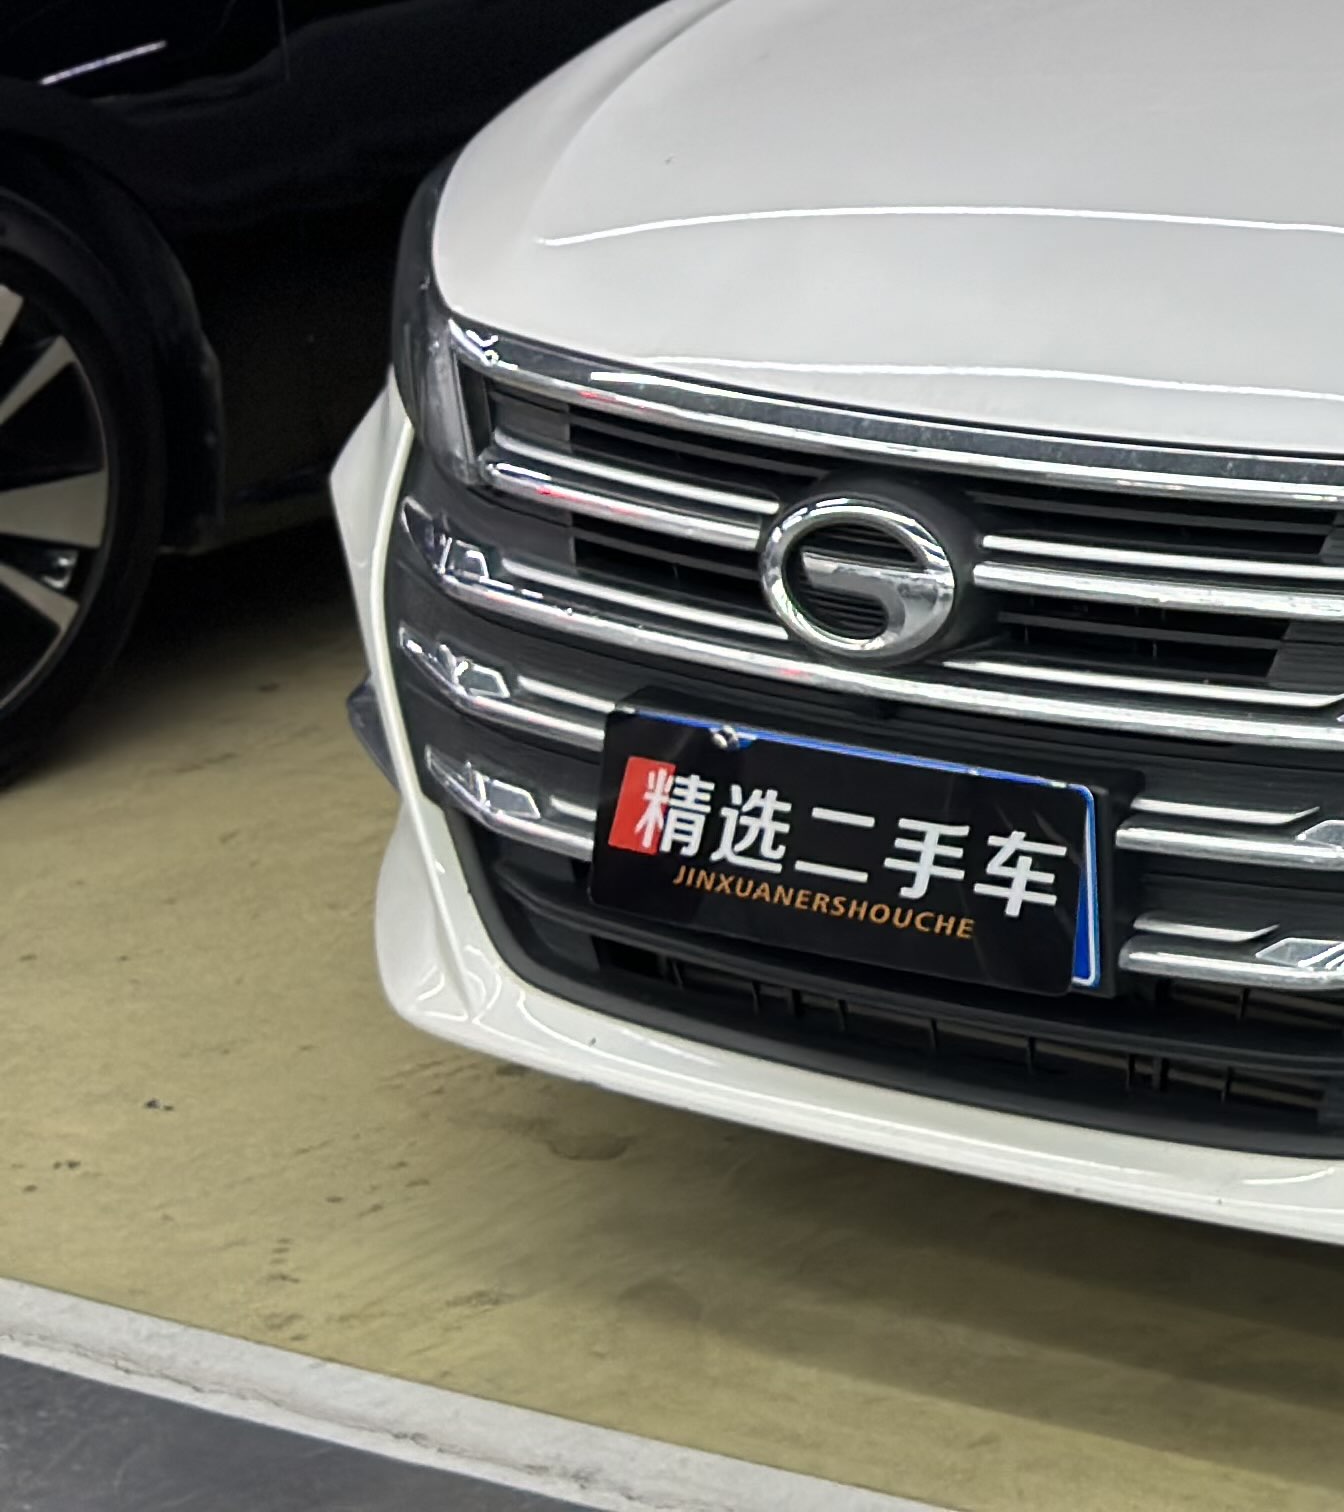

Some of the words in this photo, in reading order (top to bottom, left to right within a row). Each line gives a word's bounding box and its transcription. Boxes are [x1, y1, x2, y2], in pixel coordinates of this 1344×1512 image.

[634, 767, 1067, 918] 精选二手车
[672, 864, 976, 940] JINXUANERSHOUCHE
